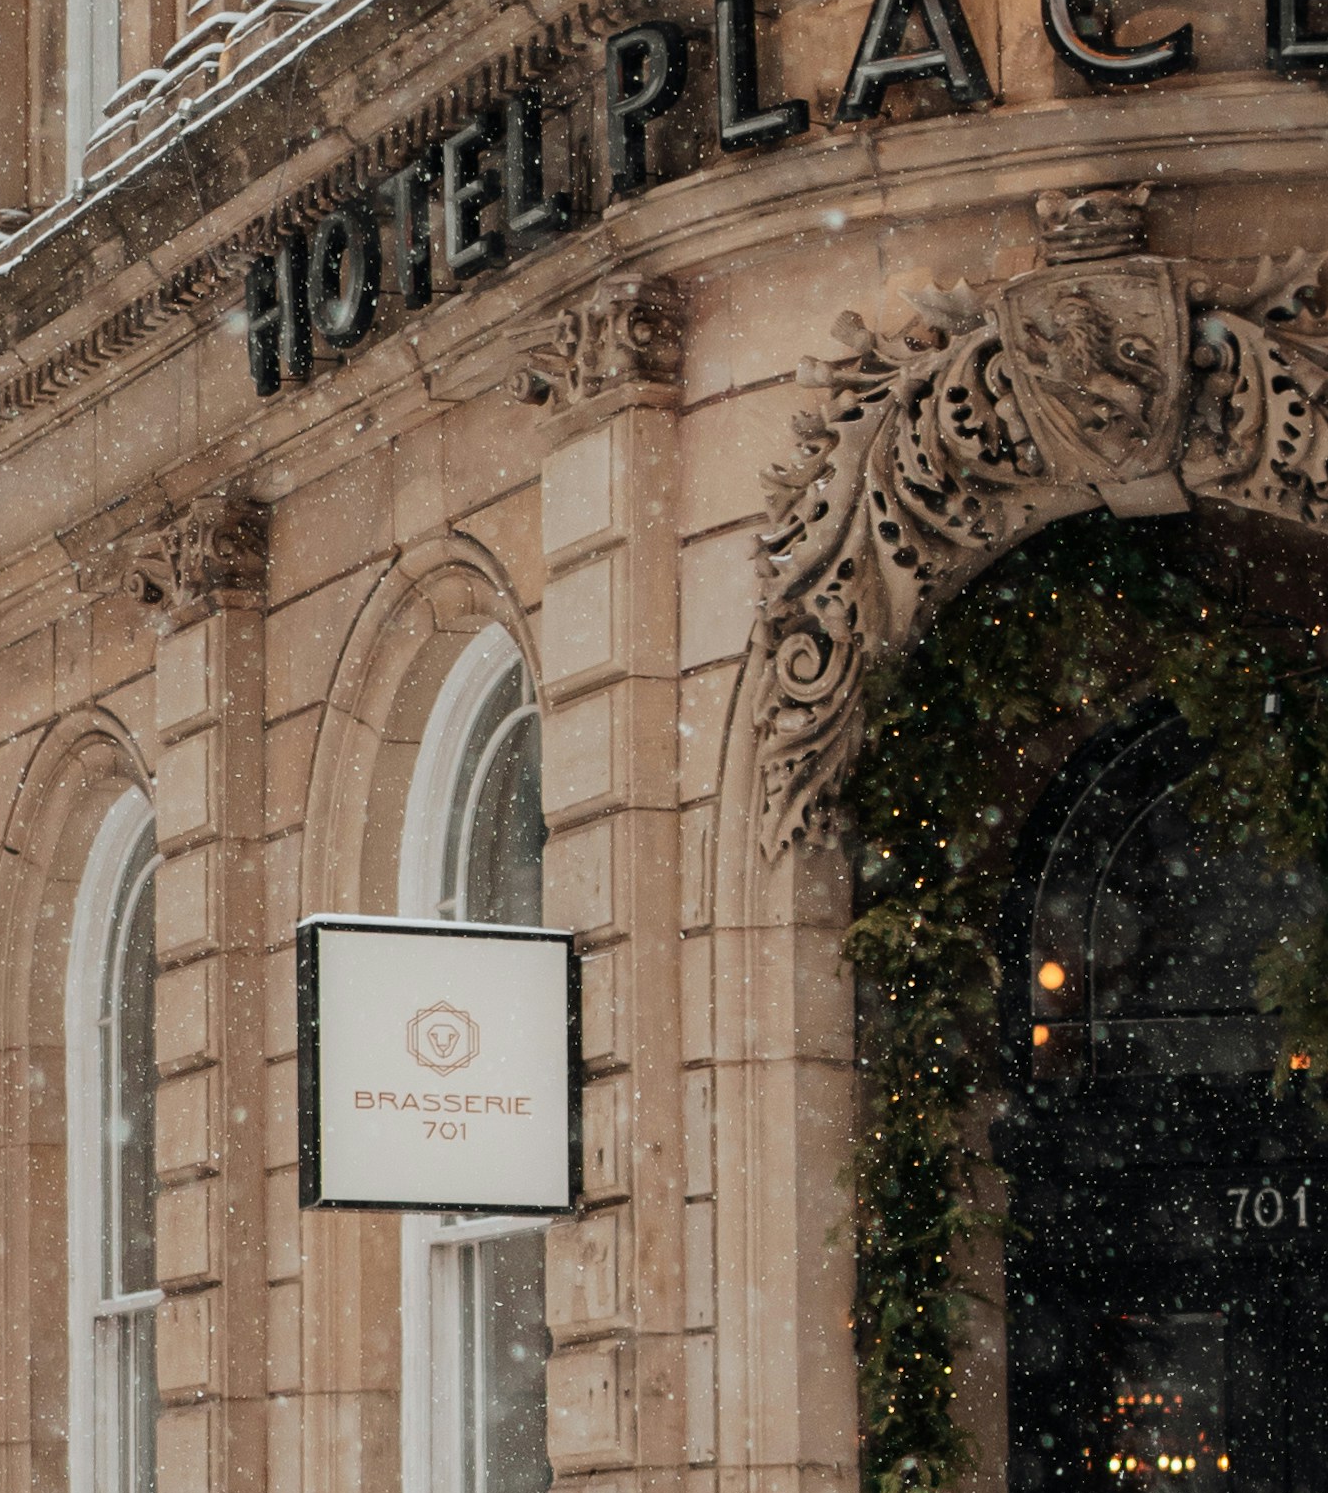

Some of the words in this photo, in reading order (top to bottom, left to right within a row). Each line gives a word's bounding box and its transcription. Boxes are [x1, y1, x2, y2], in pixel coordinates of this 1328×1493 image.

[245, 85, 575, 397] HOTEL
[355, 1090, 532, 1116] BRASSERIE
[423, 1121, 467, 1141] 701
[1226, 1186, 1308, 1228] 701
